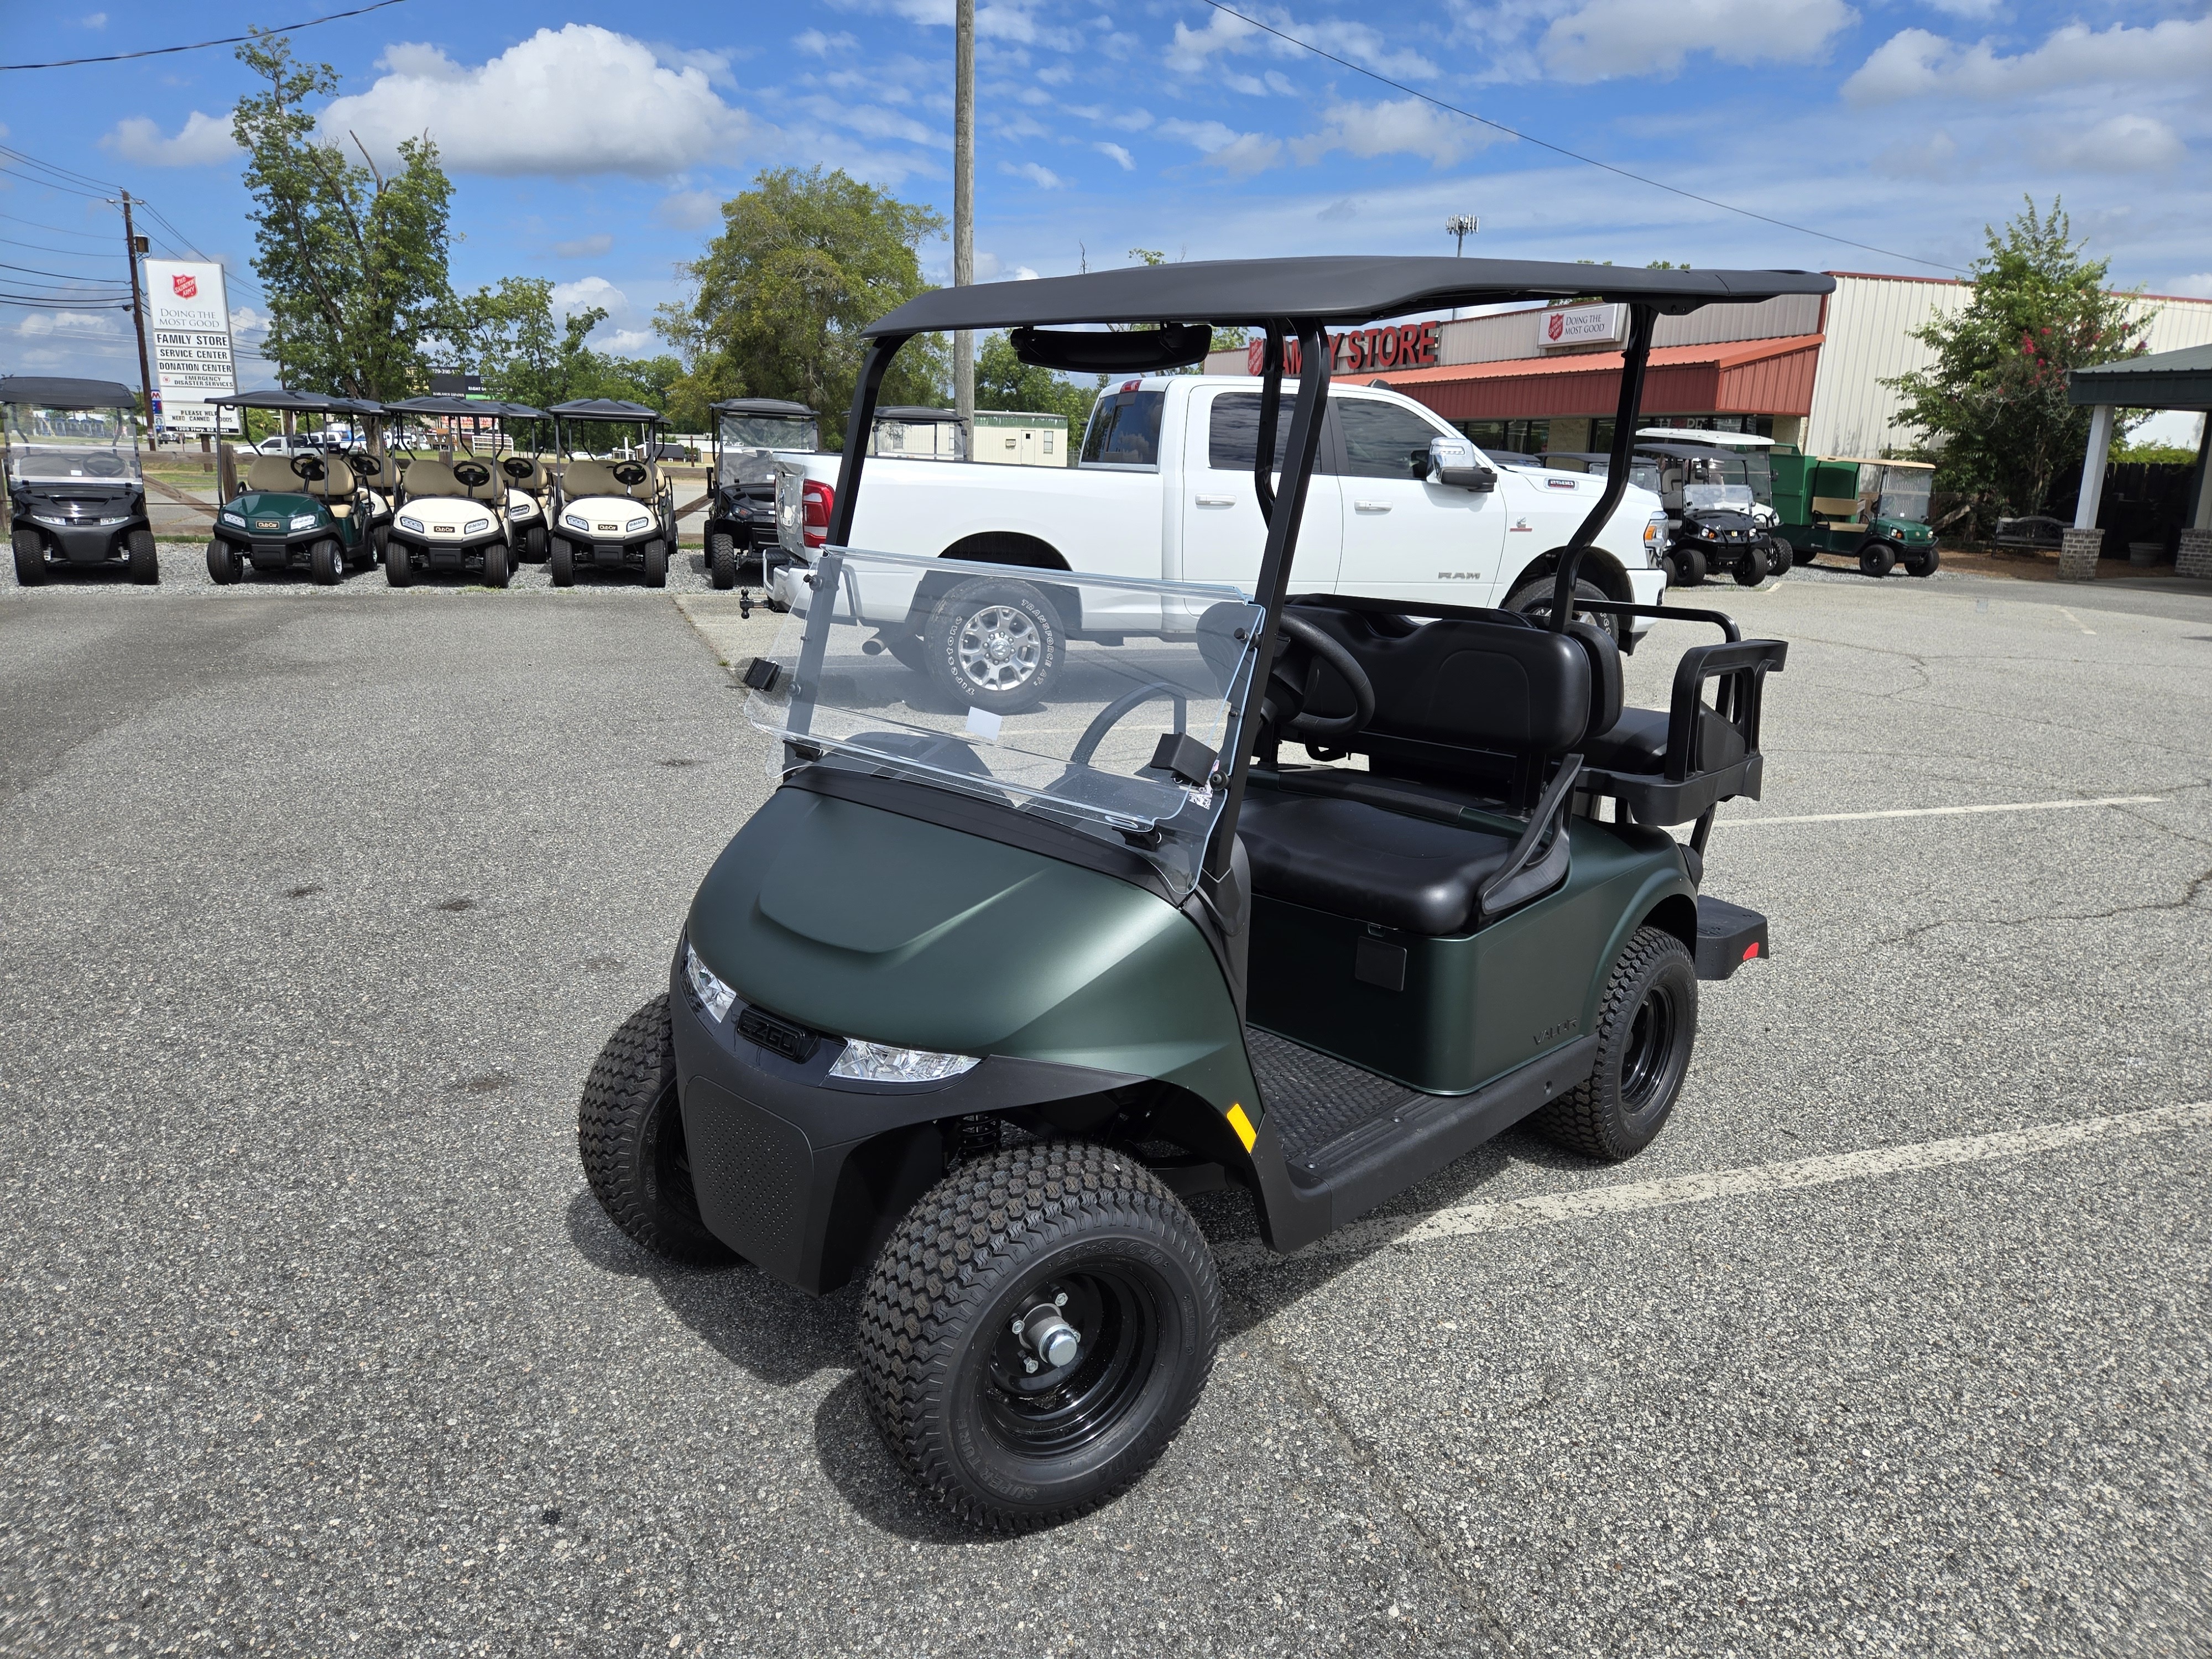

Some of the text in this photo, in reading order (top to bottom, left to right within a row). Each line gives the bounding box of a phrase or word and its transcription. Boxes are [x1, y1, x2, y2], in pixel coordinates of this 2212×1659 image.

[160, 308, 216, 319] DOING THE
[1566, 314, 1602, 326] DOING THE
[189, 319, 220, 327] GOOD
[1564, 324, 1604, 335] MOST GOOD
[156, 333, 228, 346] FAMILY STORE
[1347, 321, 1438, 369] STORE
[160, 349, 227, 359] SERVICE CENTER
[159, 362, 232, 373] DONATION CENTER
[1021, 599, 1054, 667] TRANSFORCE
[946, 616, 975, 696] Firestone
[1533, 1015, 1578, 1046] VALOR
[1097, 1414, 1165, 1484] KENDA
[979, 1465, 1039, 1500] SUPER
